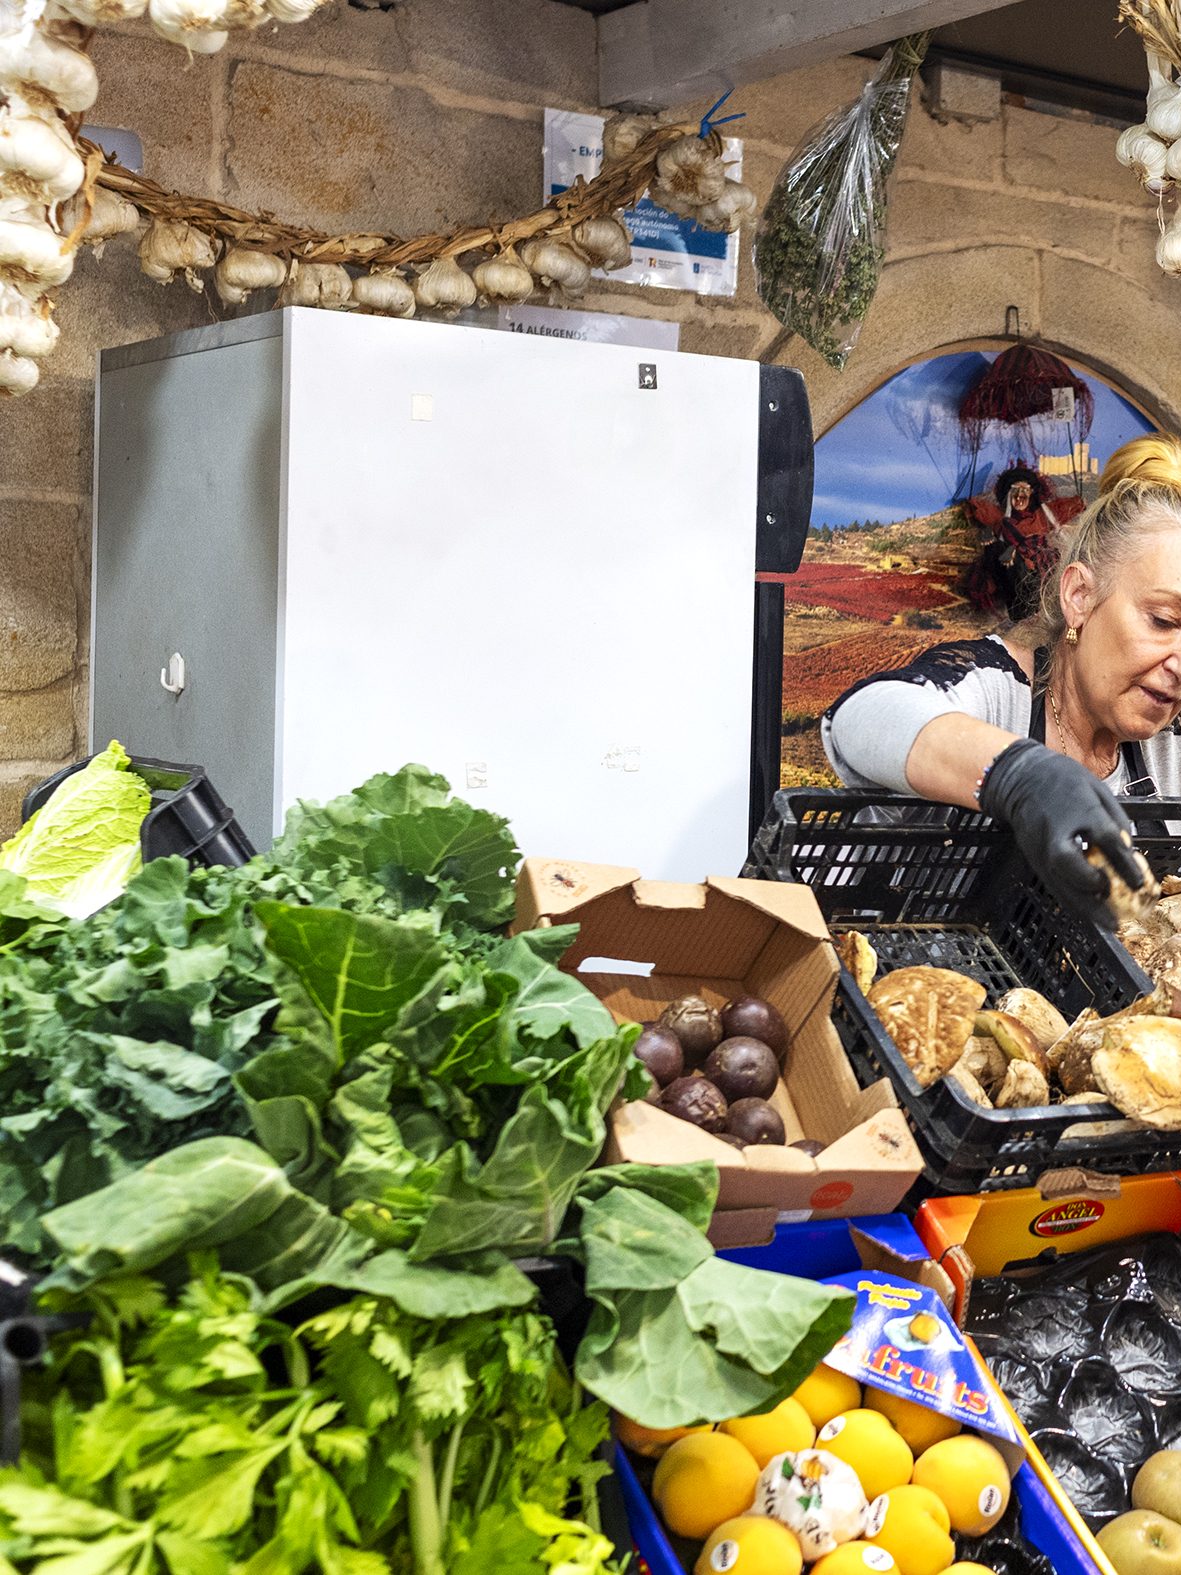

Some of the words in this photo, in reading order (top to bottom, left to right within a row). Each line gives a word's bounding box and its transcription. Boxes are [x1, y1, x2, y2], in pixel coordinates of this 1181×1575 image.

[508, 322, 523, 333] 14
[526, 324, 588, 341] ALÉRGENOS
[1046, 1207, 1097, 1222] ANGEL
